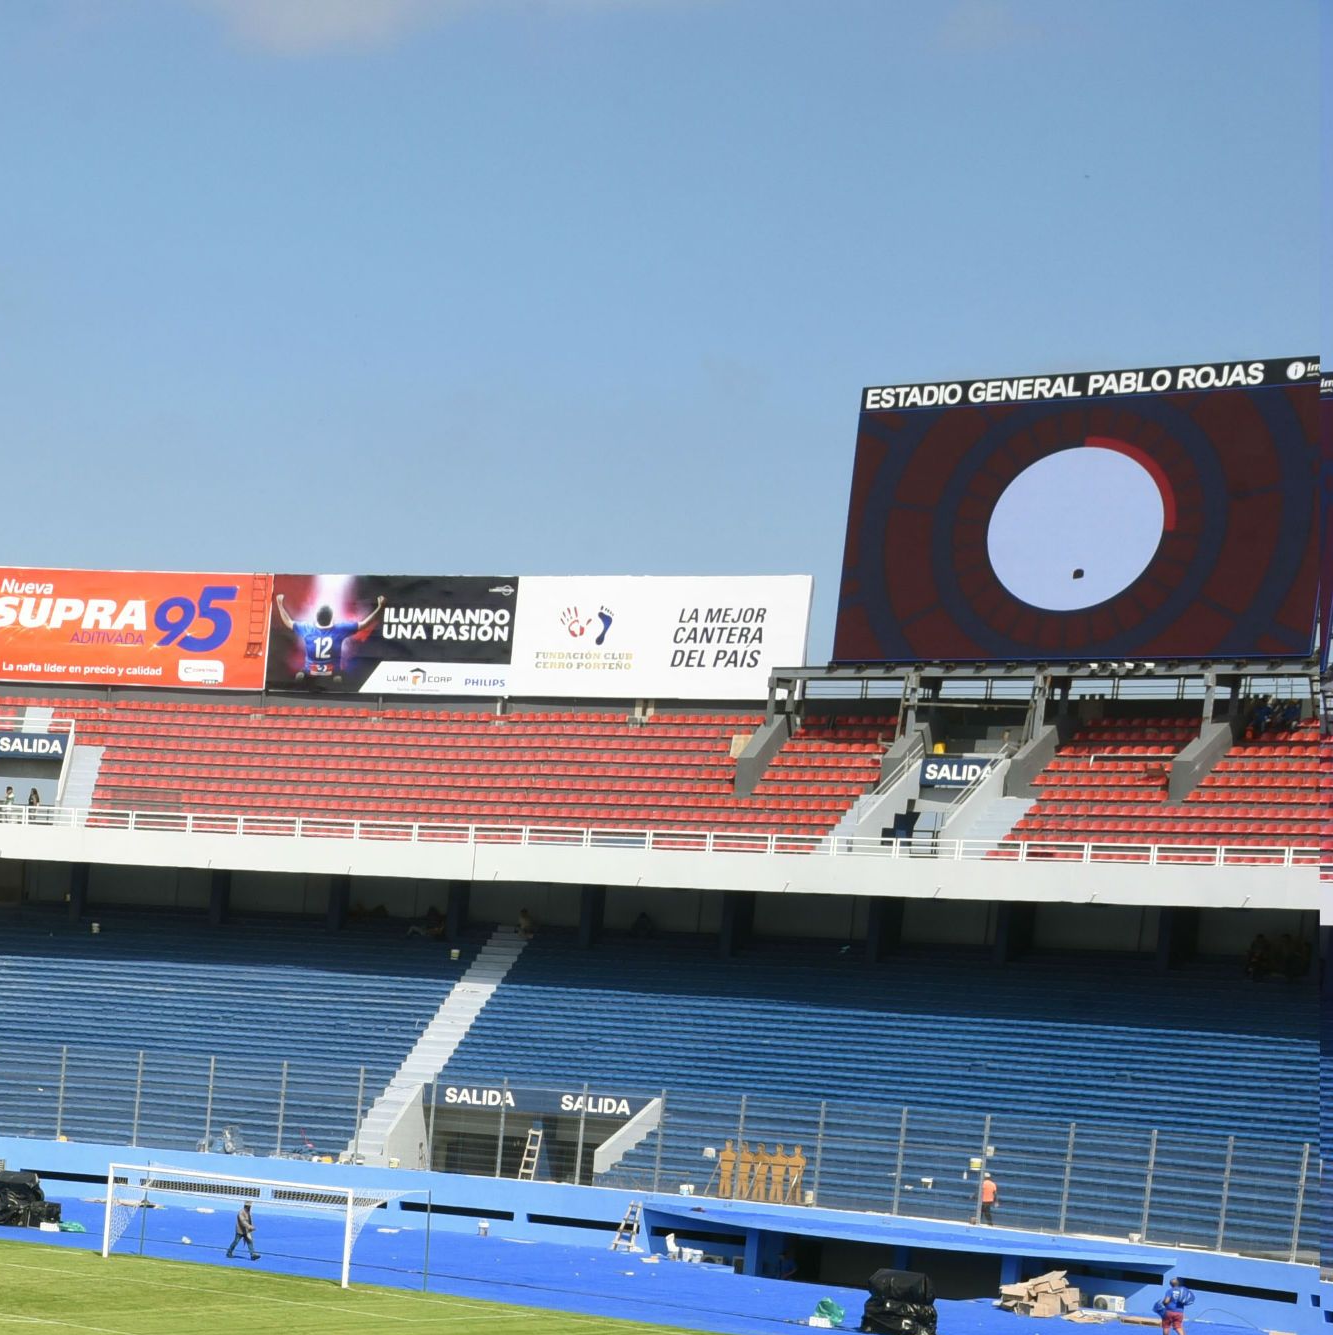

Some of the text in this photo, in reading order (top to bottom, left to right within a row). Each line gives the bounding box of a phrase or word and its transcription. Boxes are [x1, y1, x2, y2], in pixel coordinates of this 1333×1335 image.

[865, 362, 1265, 410] ESTADIO GENERAL PABLO ROJAS
[0, 578, 54, 595] Nueva
[153, 585, 239, 652] 95
[384, 607, 511, 625] ILUMINANDO
[678, 607, 767, 623] LA MEJOR
[69, 631, 145, 645] ADITIVADA
[383, 623, 509, 642] UNA PASIÓN
[673, 626, 763, 644] CANTERA
[314, 636, 333, 658] 12
[535, 651, 633, 660] FUNDACIÓN CLUB
[535, 660, 632, 670] CERRO PORTEÑO
[670, 645, 761, 668] DEL PAÍS
[2, 661, 14, 671] La
[16, 662, 42, 672] nafta
[69, 664, 82, 673] en
[83, 664, 116, 676] precio
[117, 667, 124, 676] y
[126, 666, 163, 676] calidad
[386, 674, 409, 682] LUMI
[464, 678, 506, 687] PHILIPS
[0, 737, 63, 755] SALIDA
[445, 1087, 516, 1107] SALIDA
[561, 1094, 631, 1115] SALIDA
